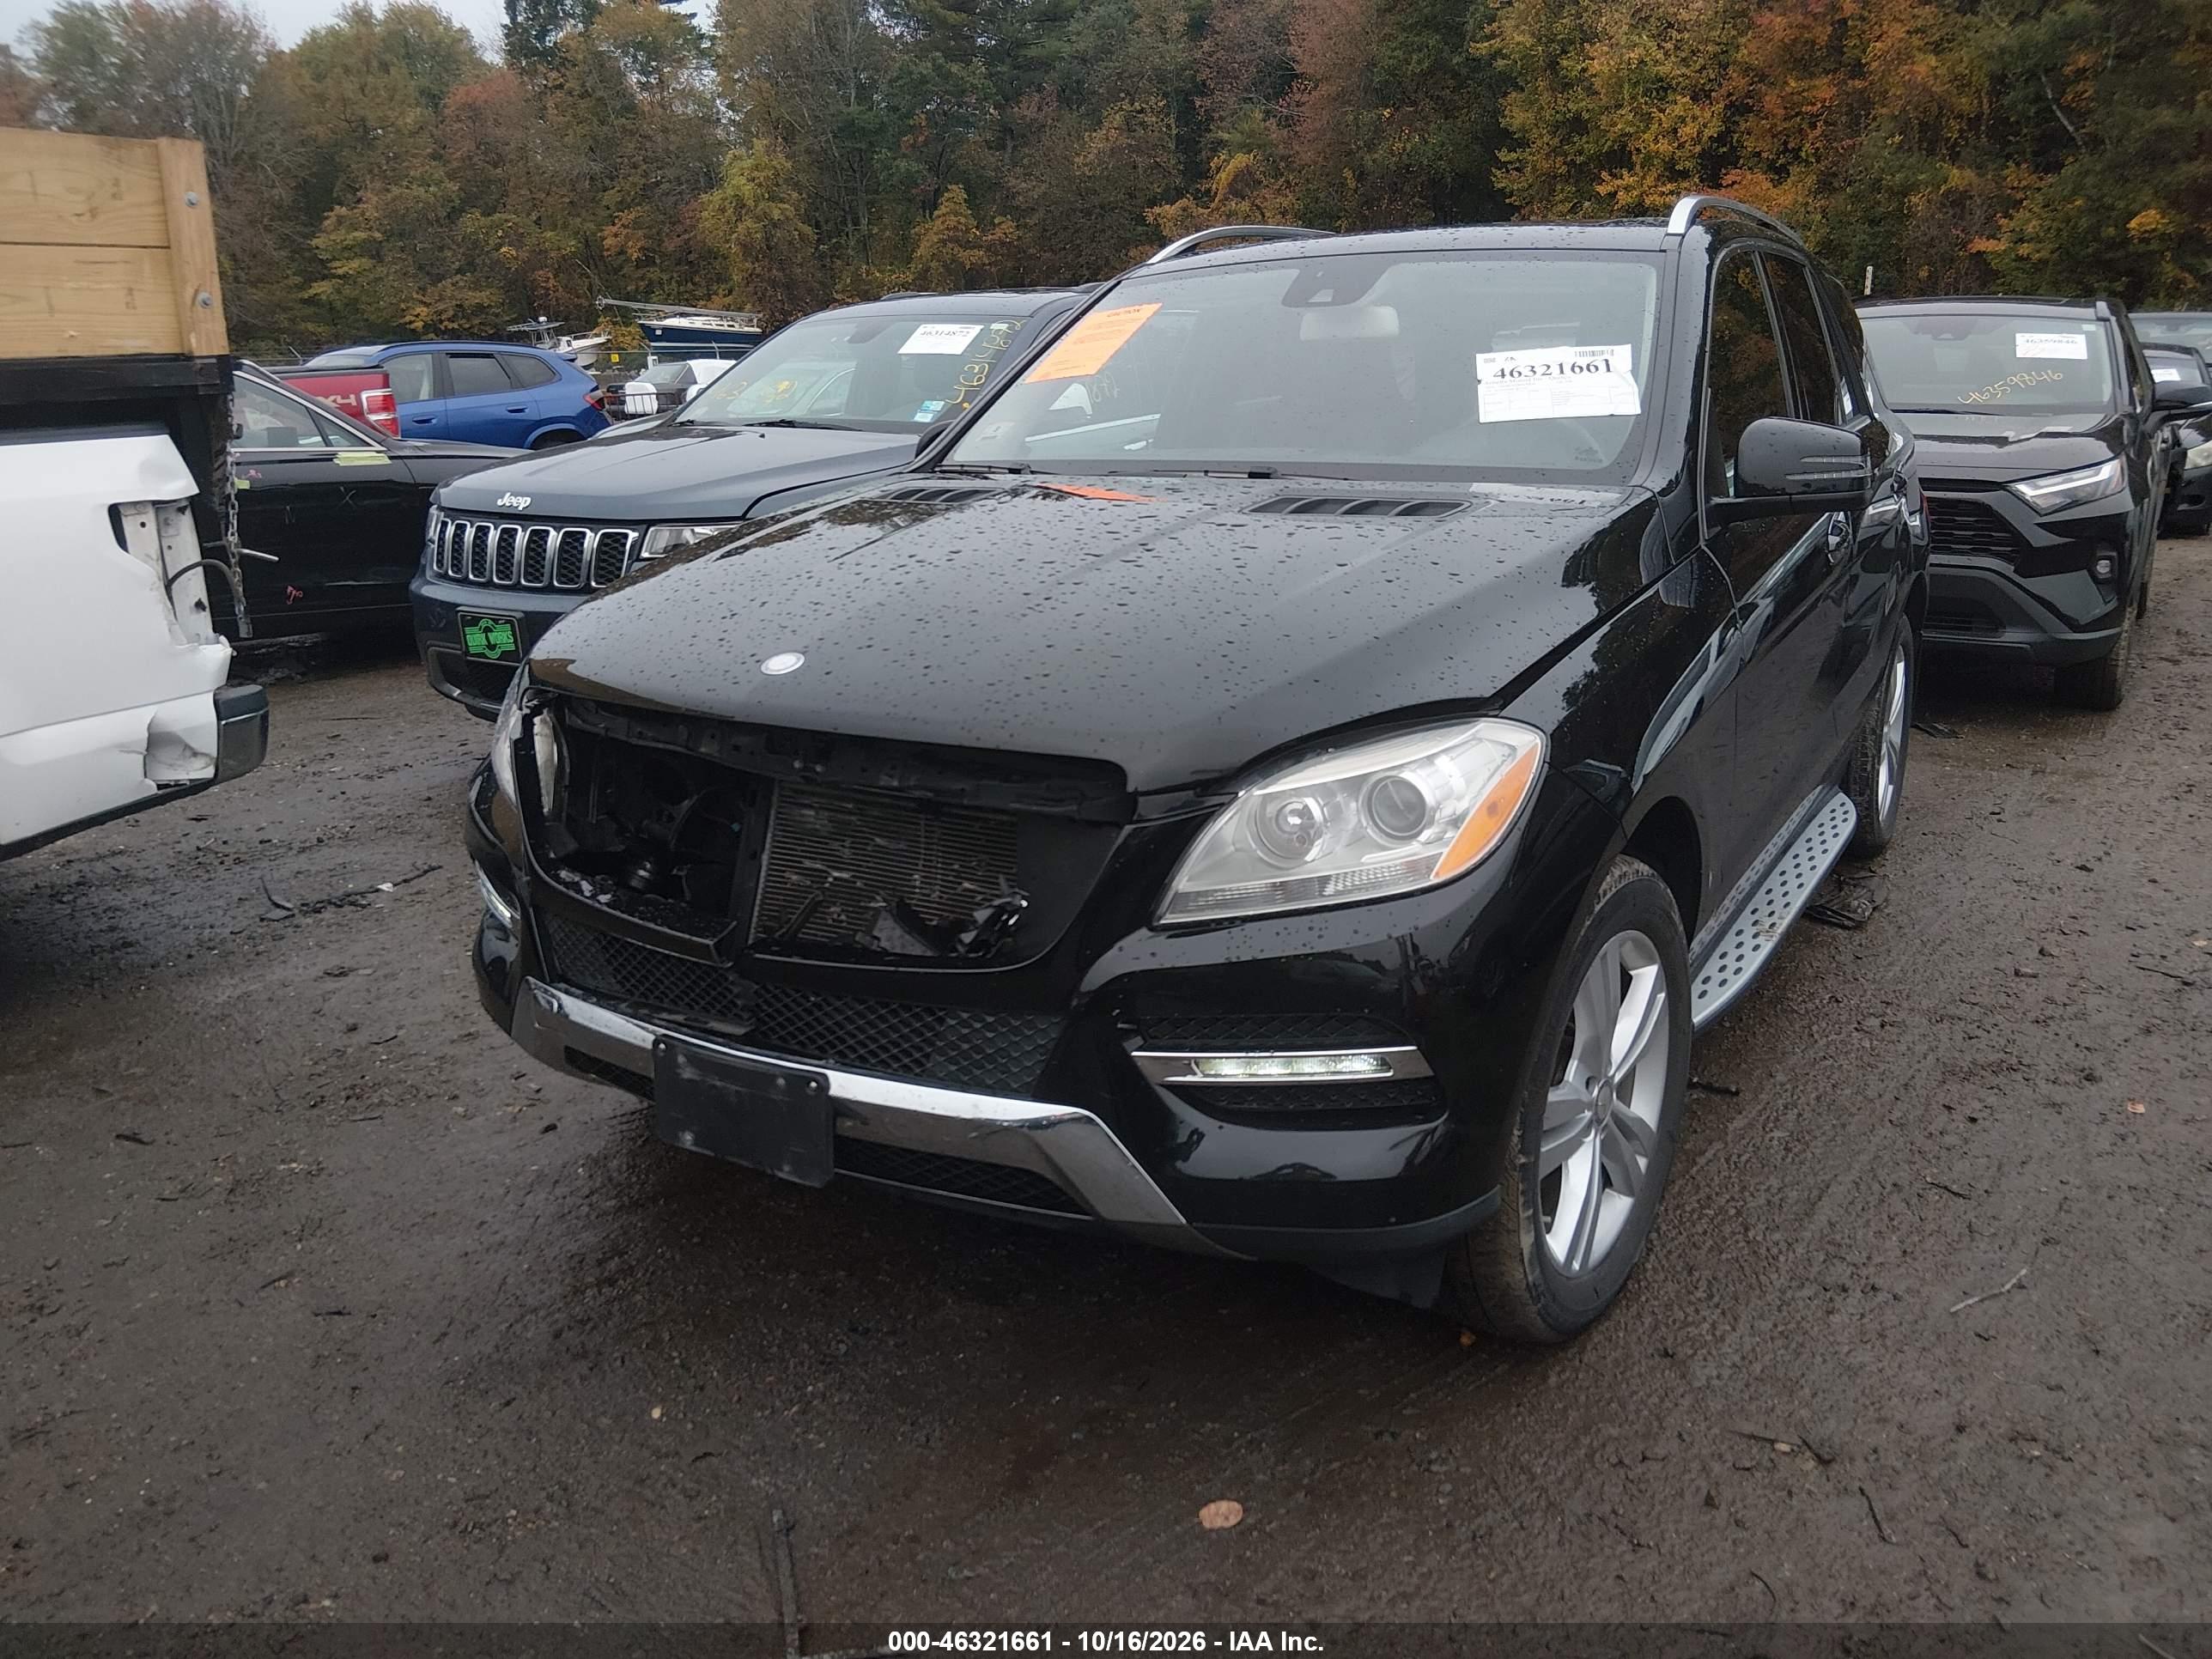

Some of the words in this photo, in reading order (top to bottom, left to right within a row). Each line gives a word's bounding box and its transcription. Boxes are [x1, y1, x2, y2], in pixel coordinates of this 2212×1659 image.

[1492, 358, 1613, 380] 46321661
[1957, 369, 2063, 404] 46359846
[496, 492, 532, 510] Jeep
